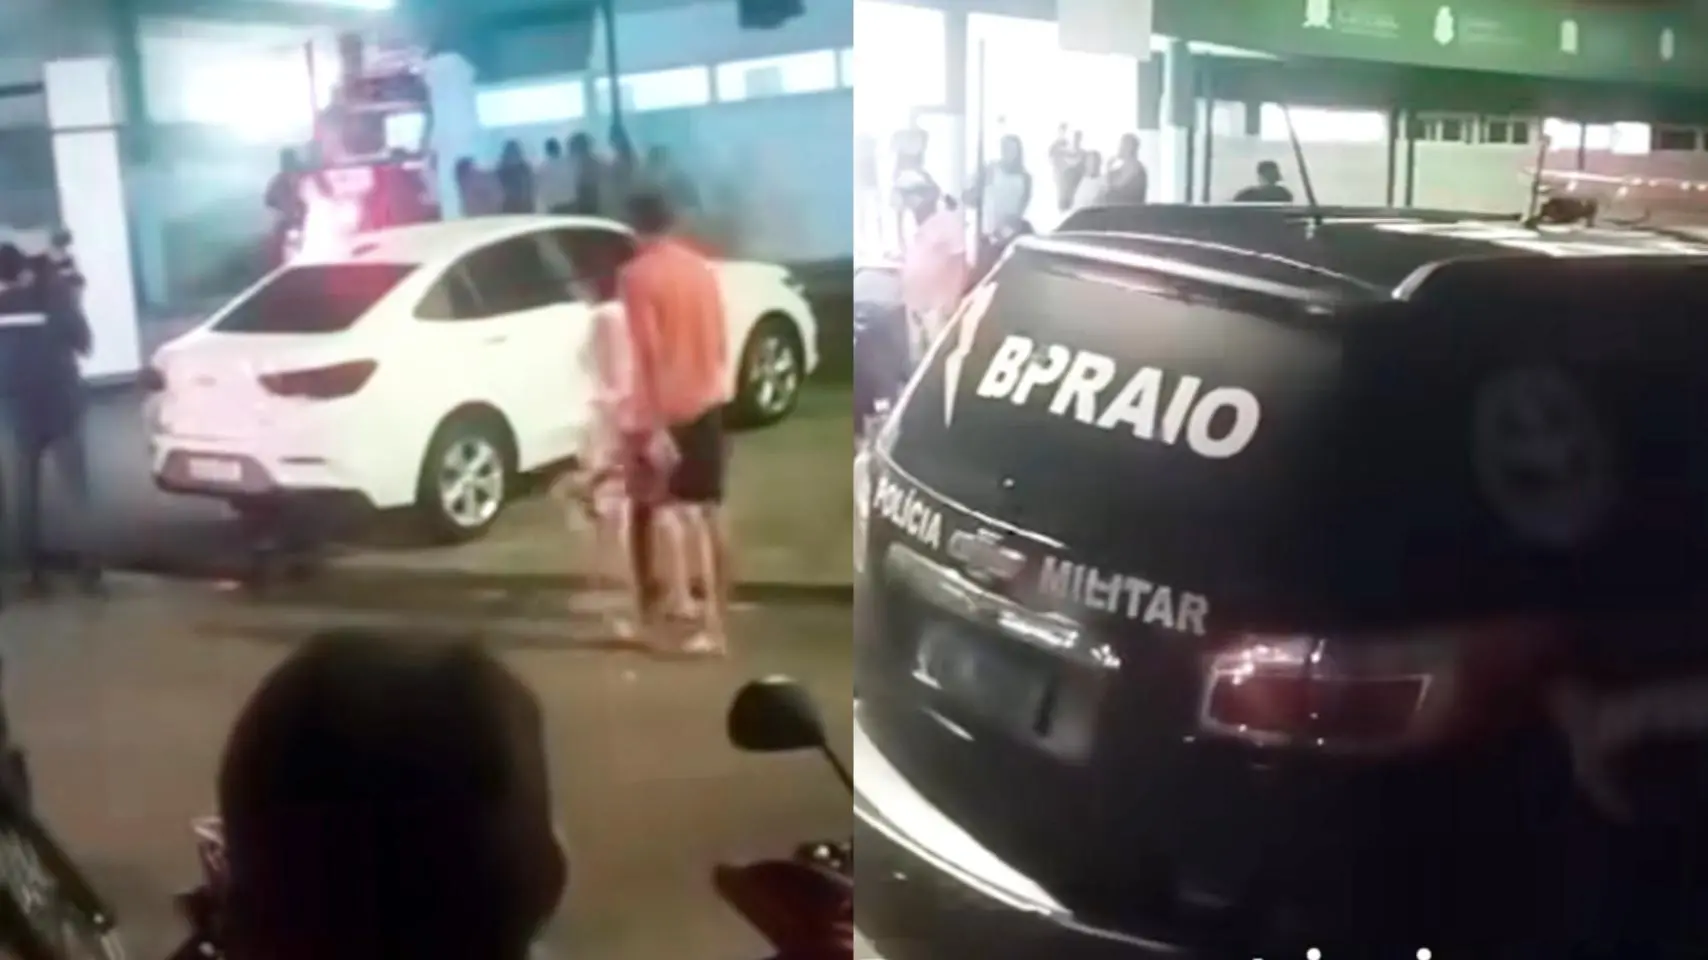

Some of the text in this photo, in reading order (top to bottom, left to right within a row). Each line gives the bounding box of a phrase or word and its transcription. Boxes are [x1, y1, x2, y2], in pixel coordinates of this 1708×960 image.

[976, 335, 1260, 458] BPRAIO
[873, 476, 1210, 636] POLÍCIA MILITAR
